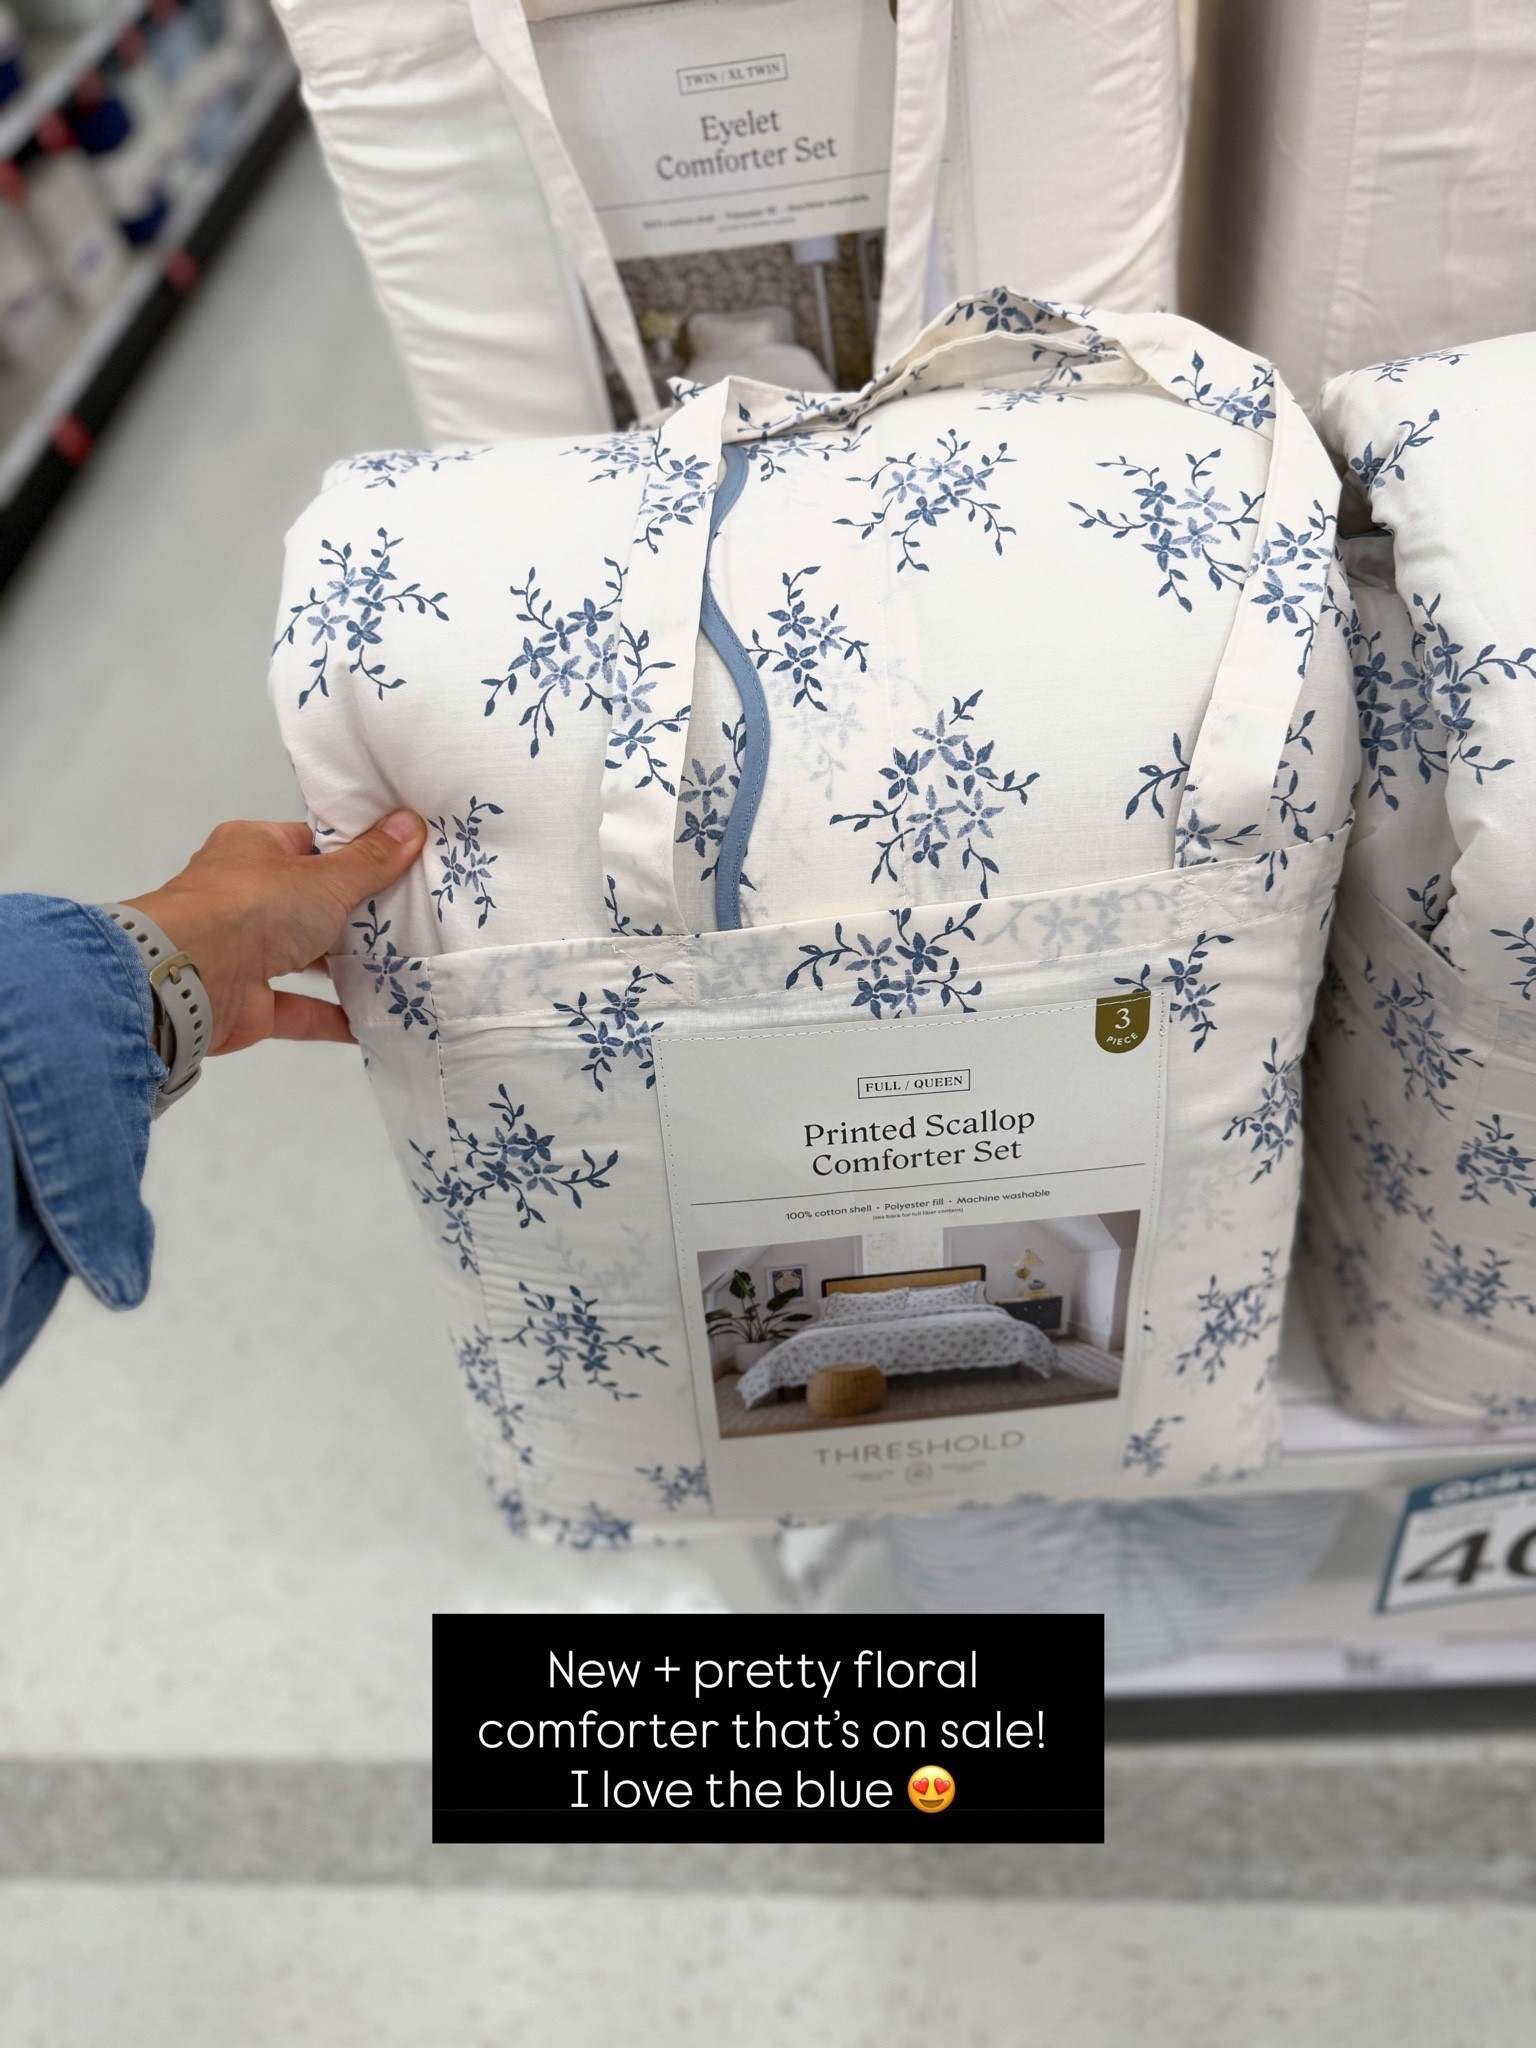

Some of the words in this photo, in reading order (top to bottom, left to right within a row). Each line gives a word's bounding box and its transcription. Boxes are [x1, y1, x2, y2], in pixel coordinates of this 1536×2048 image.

[684, 72, 719, 87] TWIN
[727, 67, 744, 81] XL
[746, 62, 781, 78] TWIN
[700, 109, 781, 146] Eyelet
[656, 146, 788, 181] Comforter
[794, 136, 837, 164] Set
[1114, 1007, 1131, 1030] 3
[1105, 1032, 1139, 1046] PIECE
[865, 1081, 901, 1093] FULL
[913, 1075, 964, 1089] QUEEN
[803, 1115, 916, 1147] Printed
[925, 1108, 1035, 1138] Scallop
[812, 1147, 966, 1176] Comforter
[973, 1140, 1022, 1163] Set
[786, 1210, 813, 1220] 100%
[814, 1206, 848, 1218] cotton
[849, 1204, 872, 1214] shell
[884, 1200, 930, 1213] Polyester
[932, 1197, 944, 1206] fill
[956, 1193, 1001, 1205] Machine
[1002, 1188, 1051, 1201] washable
[815, 1430, 1025, 1465] THRESHOLD
